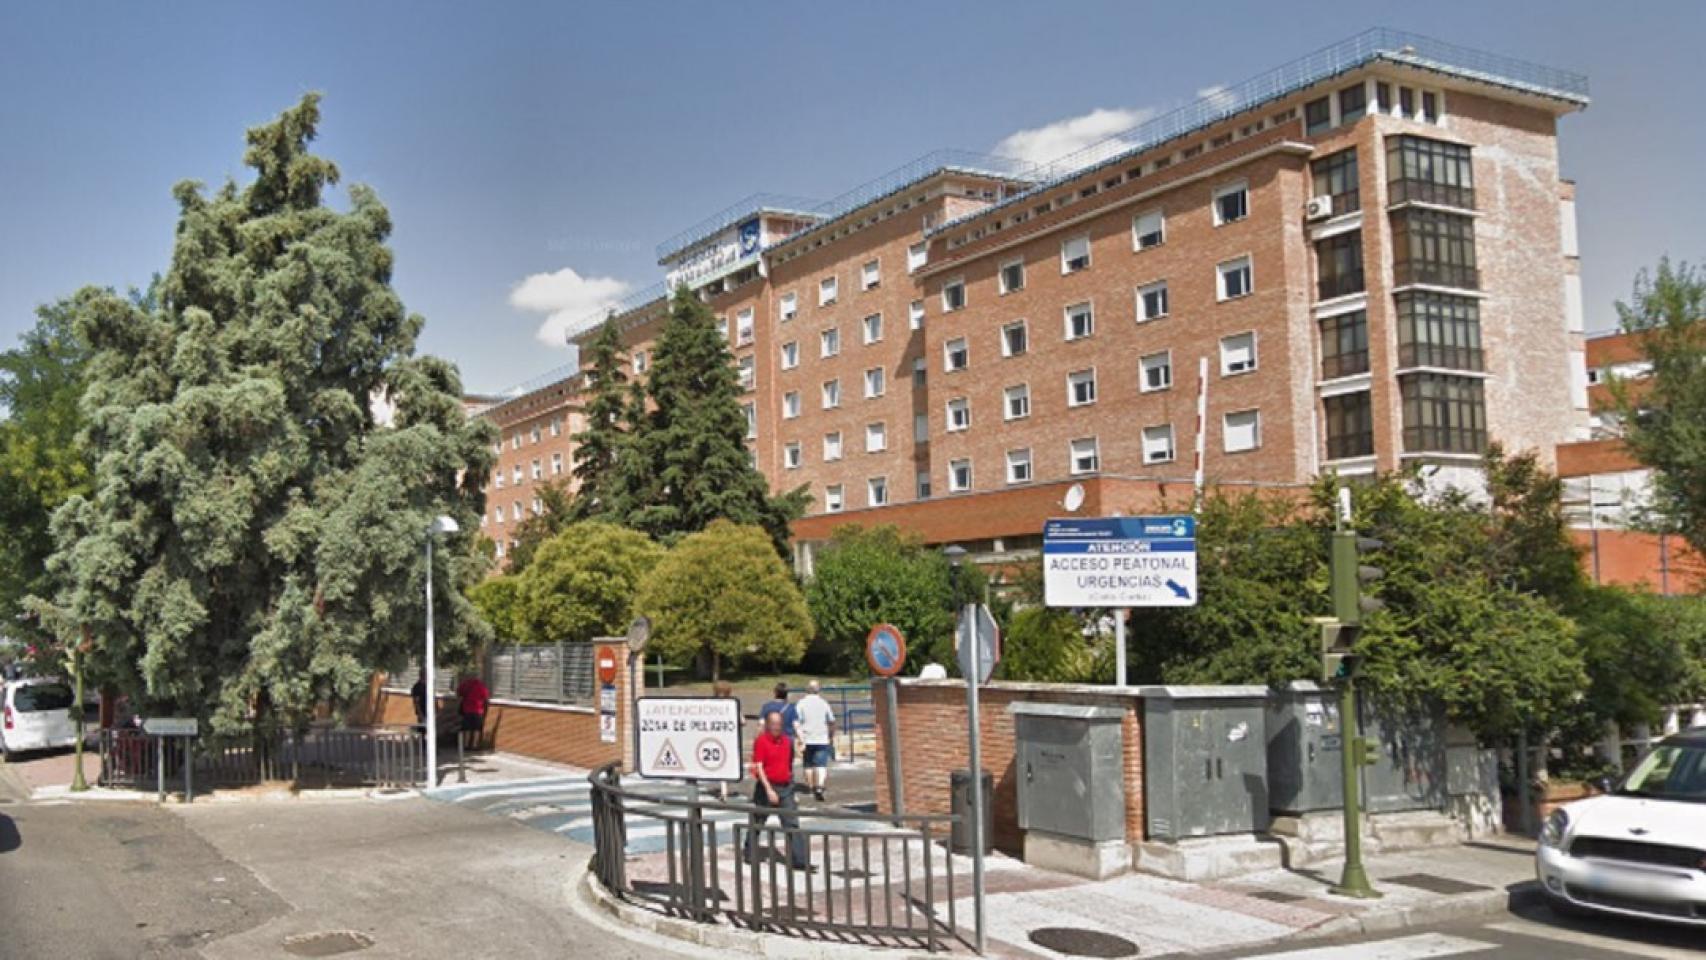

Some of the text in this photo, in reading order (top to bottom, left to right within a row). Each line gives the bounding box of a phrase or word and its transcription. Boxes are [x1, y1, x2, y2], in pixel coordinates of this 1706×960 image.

[1049, 557, 1190, 571] ACCESO PEATONAL
[1077, 574, 1162, 589] URGENCIAS
[673, 719, 687, 732] DE
[703, 748, 720, 762] 20
